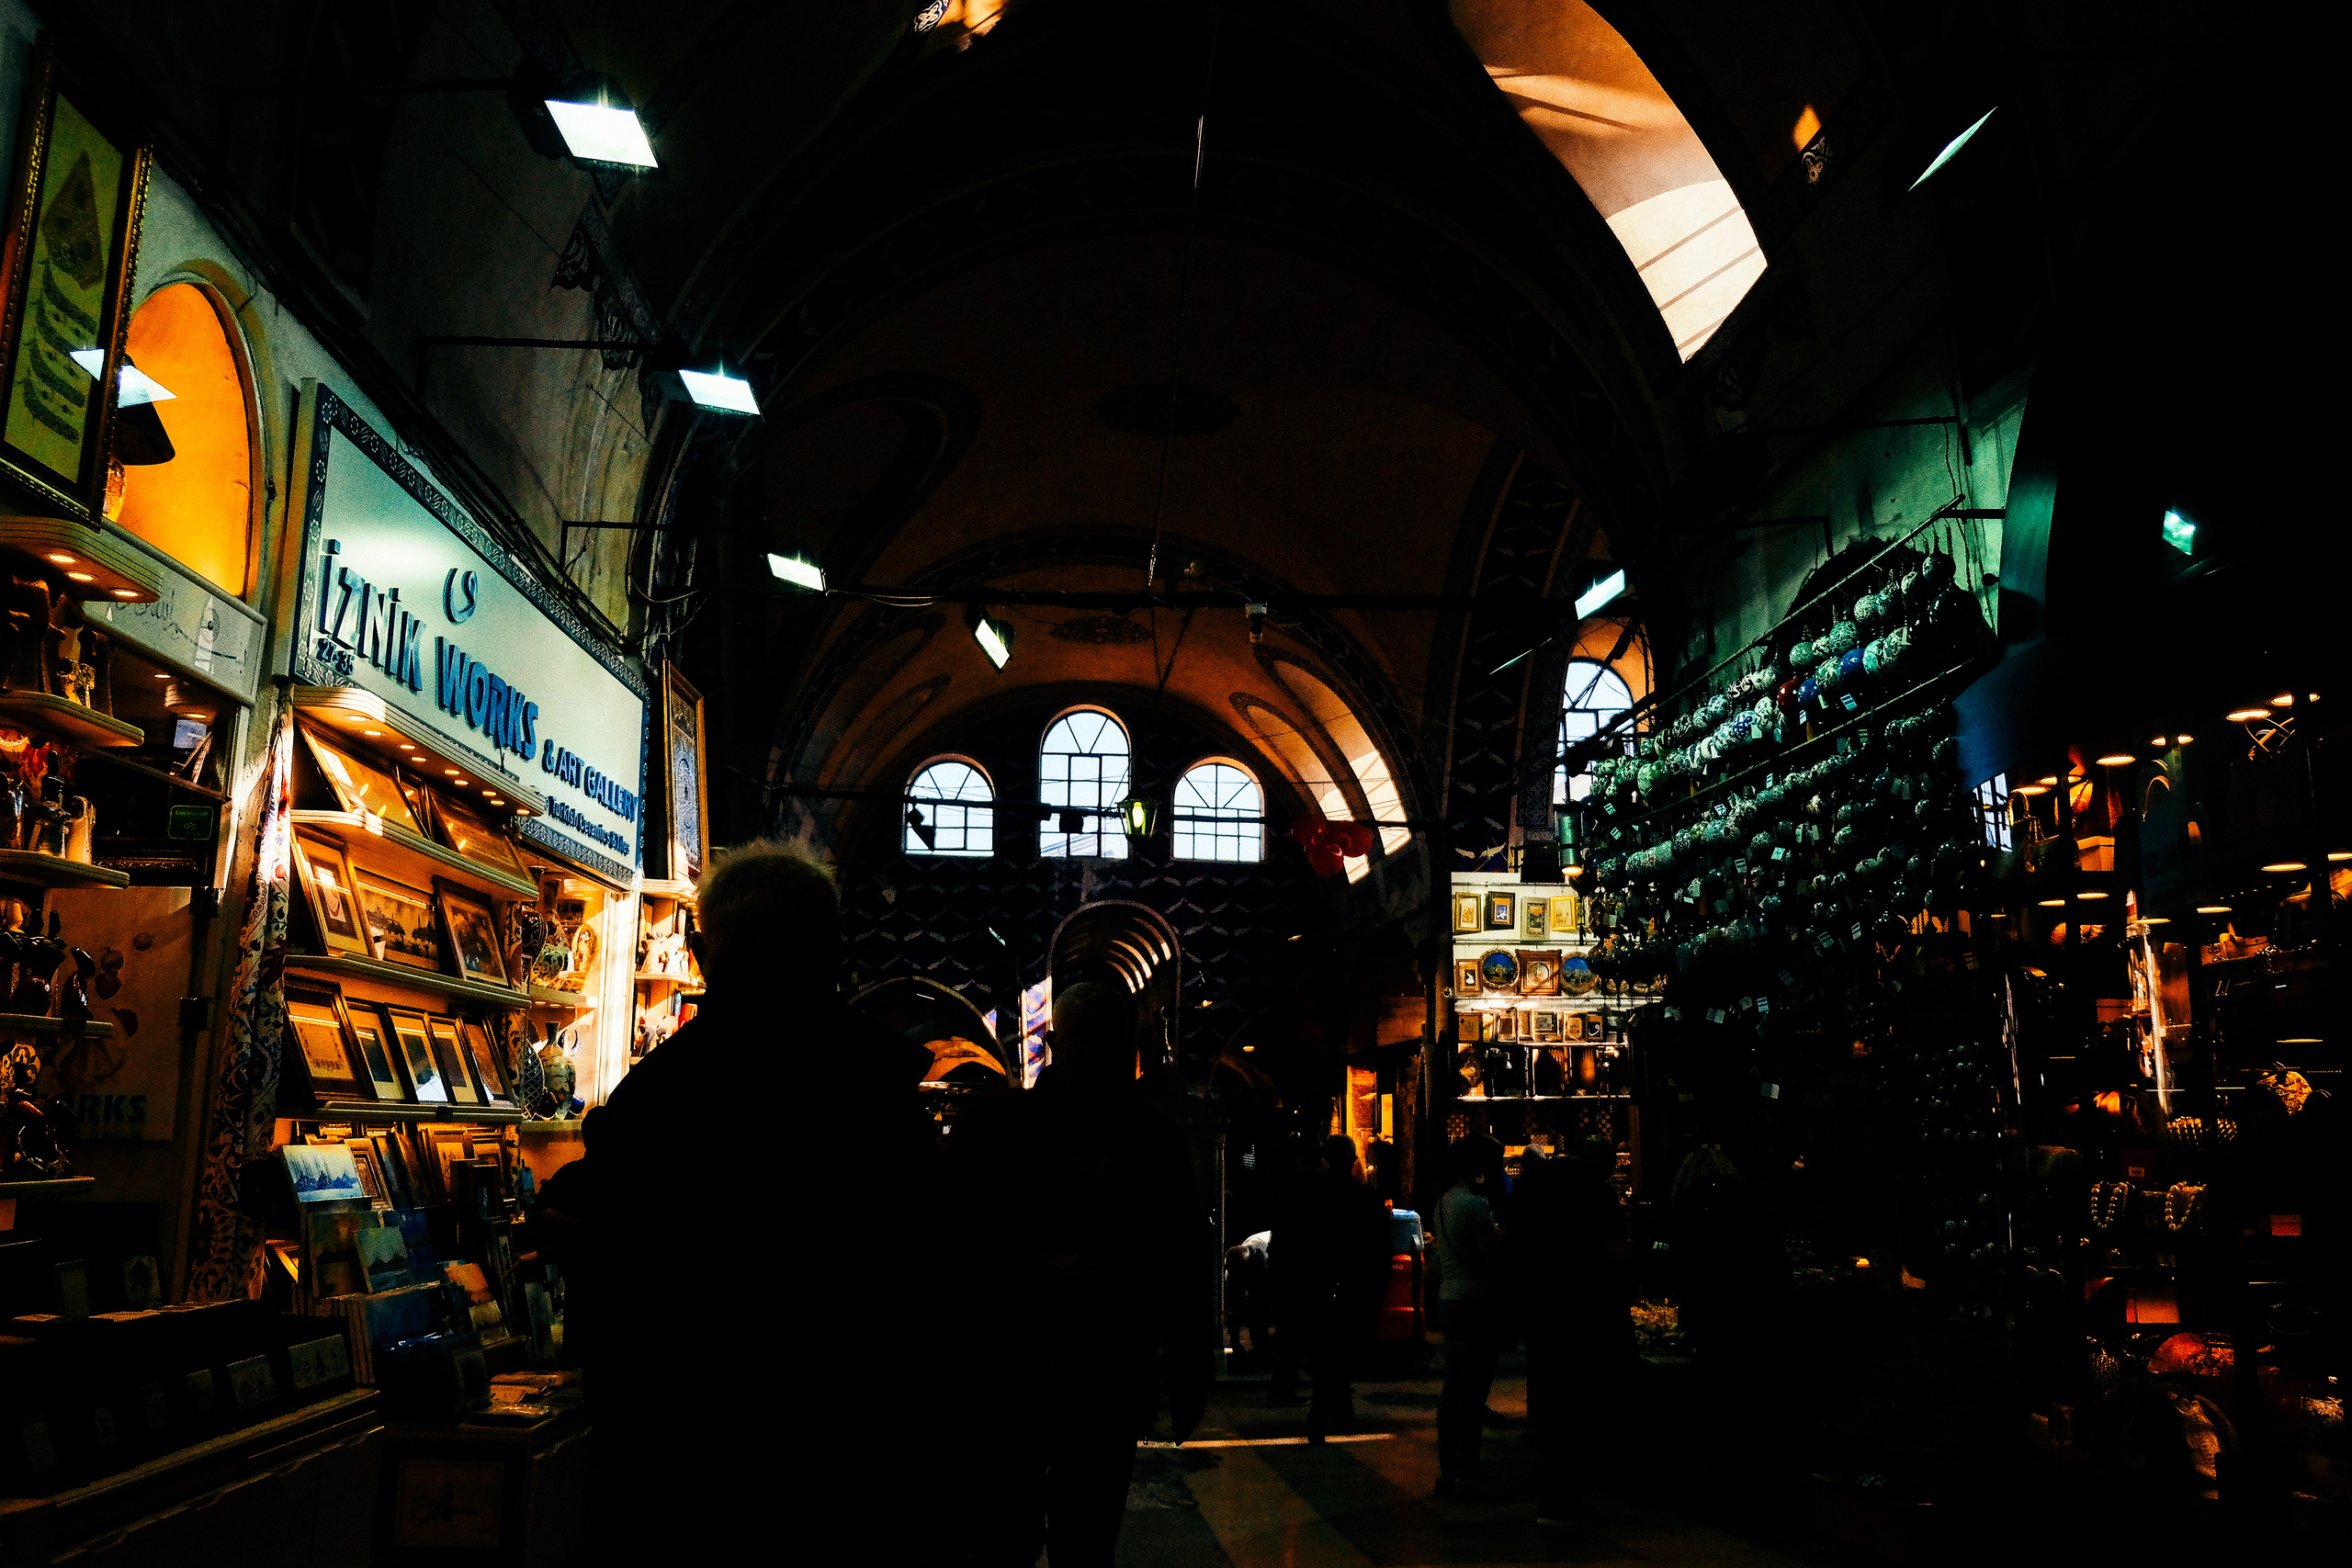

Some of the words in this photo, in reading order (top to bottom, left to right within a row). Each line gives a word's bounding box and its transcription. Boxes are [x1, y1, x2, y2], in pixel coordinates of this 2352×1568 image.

[315, 538, 427, 691] İZNİK
[435, 636, 538, 760] WORKS
[542, 739, 554, 773] &
[555, 747, 584, 788] ART
[584, 766, 639, 823] GALLERY
[548, 795, 579, 829] Turkish
[577, 812, 610, 846] Ceramics
